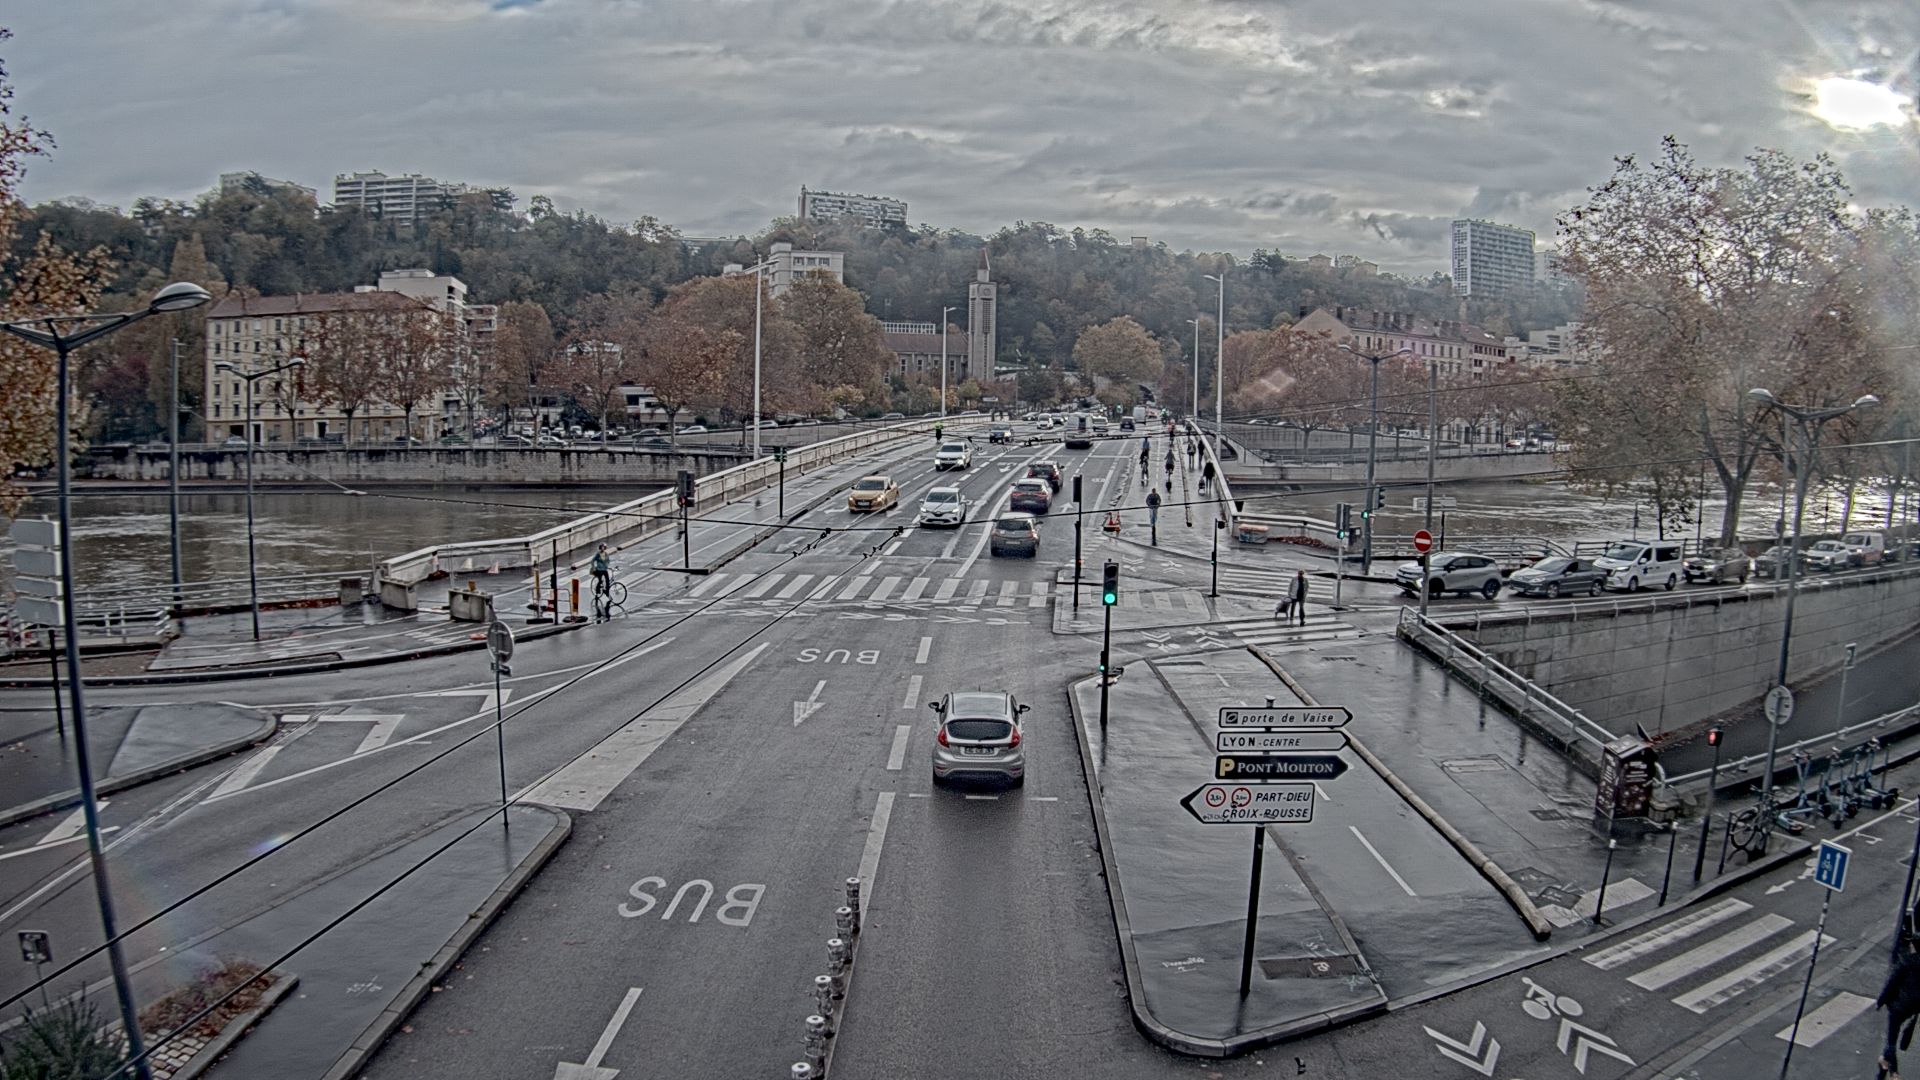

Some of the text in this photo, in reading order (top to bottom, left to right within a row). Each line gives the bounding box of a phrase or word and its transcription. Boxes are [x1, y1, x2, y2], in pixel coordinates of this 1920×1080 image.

[796, 648, 881, 665] BUS
[1241, 712, 1335, 725] porte de Vaise
[1219, 758, 1334, 777] P PONT MOUTON
[1255, 792, 1311, 802] PART-DIEU
[1222, 808, 1309, 819] CROIX-ROUSSE
[617, 875, 767, 927] BUS
